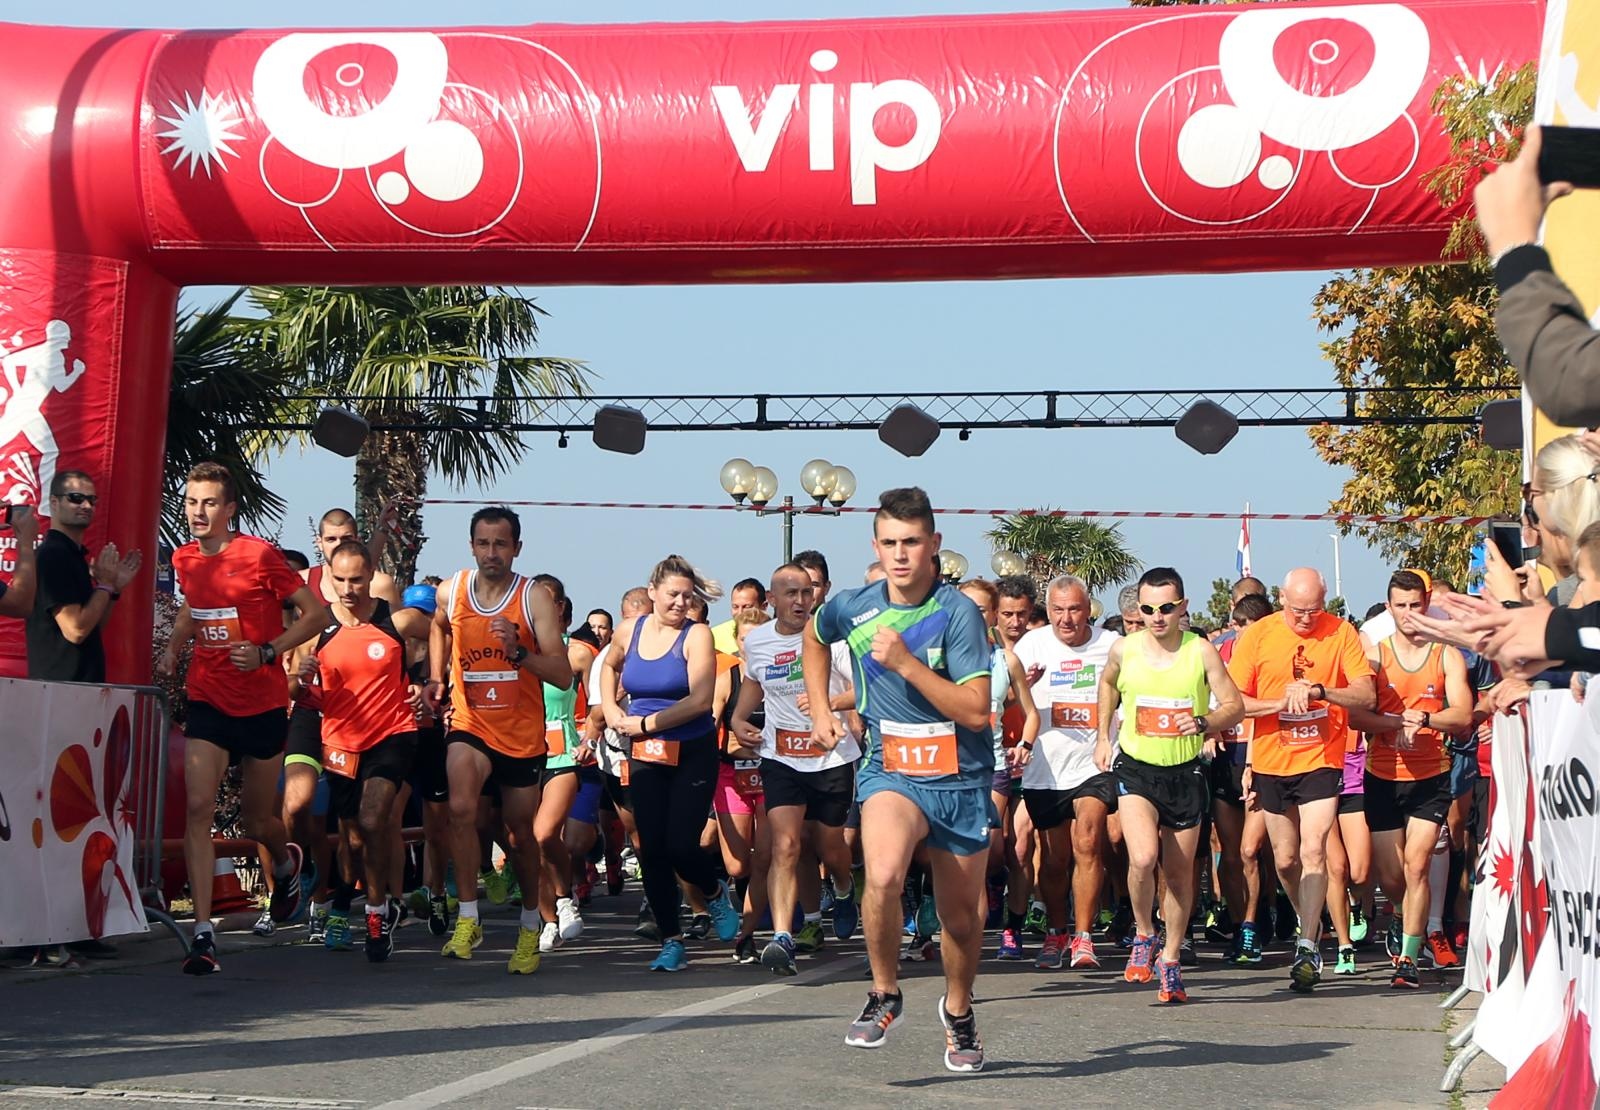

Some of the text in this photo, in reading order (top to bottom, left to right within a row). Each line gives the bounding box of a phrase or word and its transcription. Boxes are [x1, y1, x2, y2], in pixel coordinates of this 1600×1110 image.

[711, 49, 942, 205] vip
[201, 626, 229, 641] 155
[792, 663, 803, 674] 36
[1077, 672, 1094, 682] 365
[486, 687, 497, 701] 4
[1063, 708, 1091, 722] 128
[1158, 714, 1169, 729] 3
[1291, 725, 1319, 739] 133
[645, 740, 663, 756] 93
[785, 736, 811, 751] 127
[329, 751, 346, 766] 44
[898, 745, 939, 765] 117
